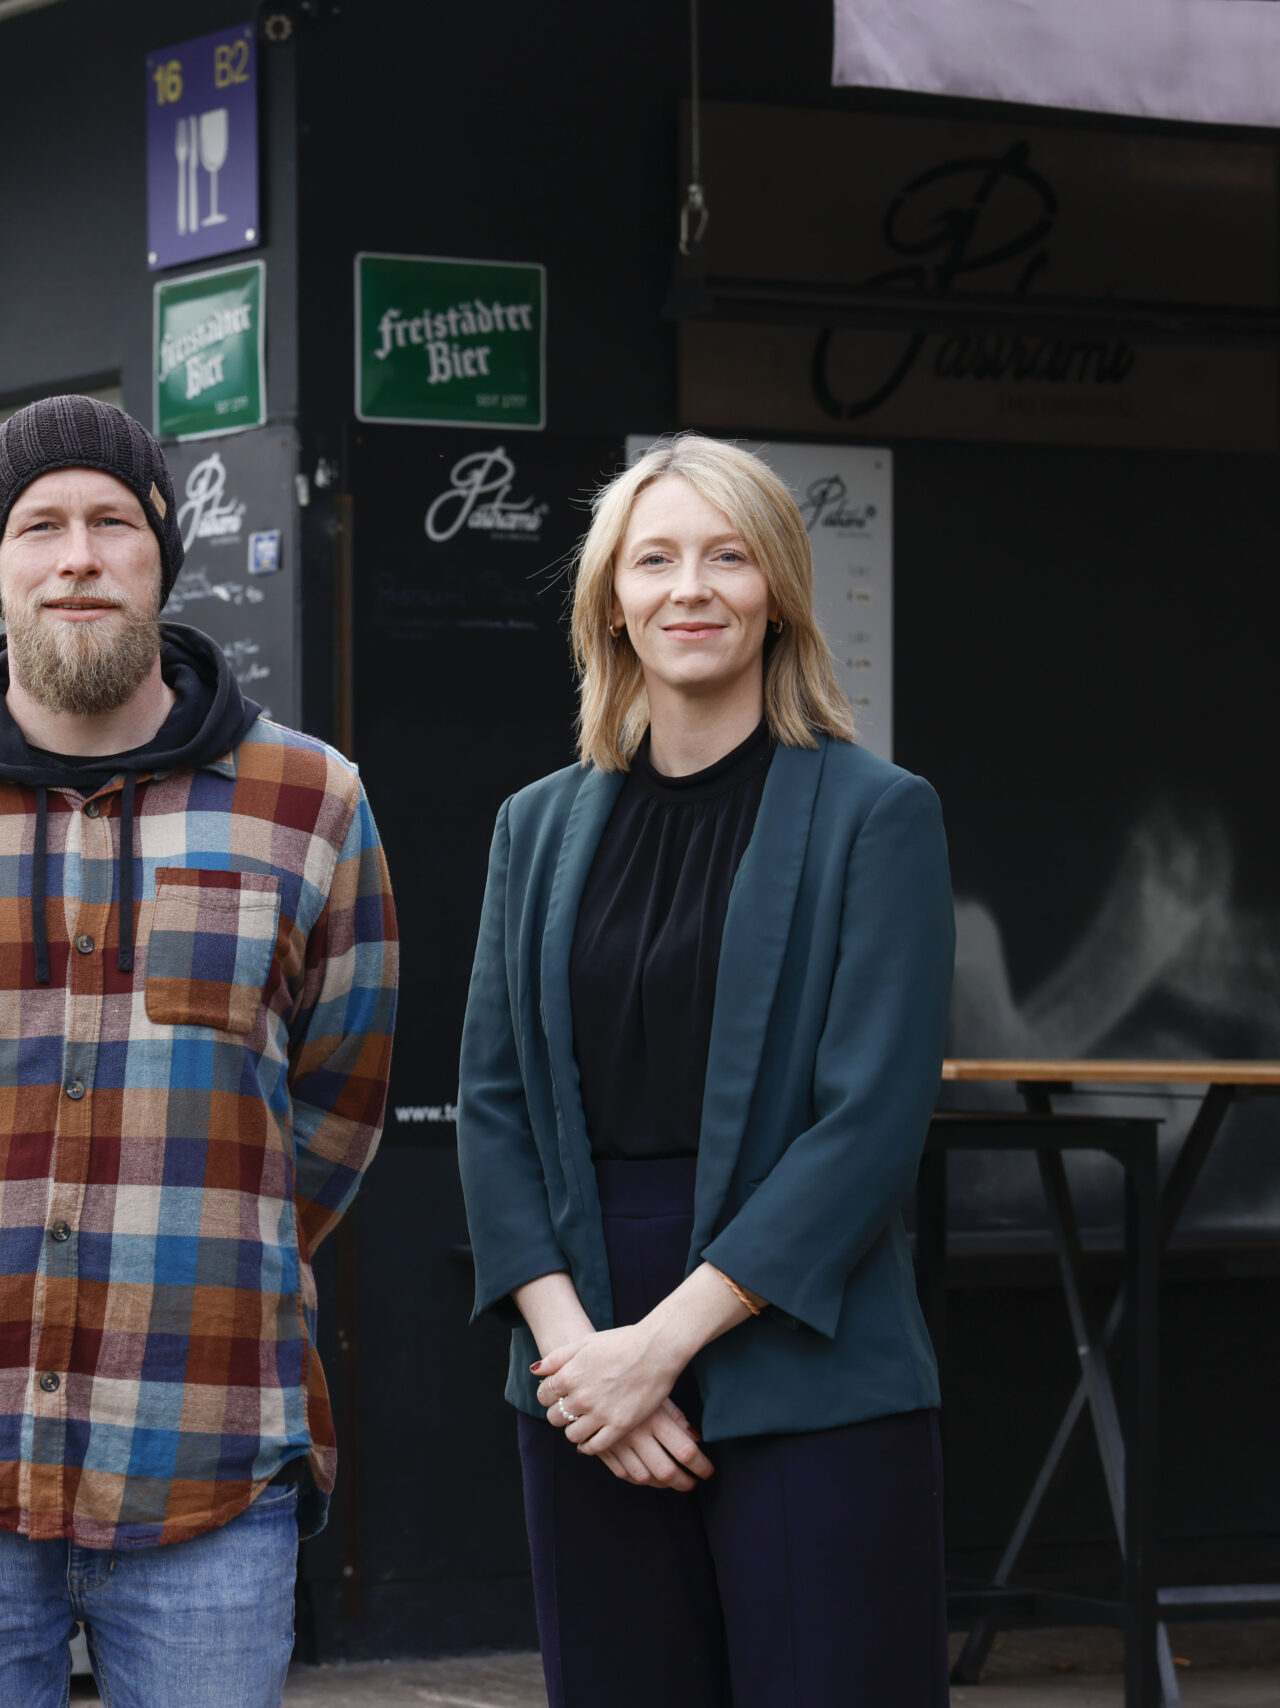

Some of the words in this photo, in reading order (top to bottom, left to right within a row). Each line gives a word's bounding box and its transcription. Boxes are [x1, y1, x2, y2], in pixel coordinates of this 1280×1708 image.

[153, 60, 183, 106] 16
[214, 39, 250, 89] B2
[185, 351, 225, 400] Bier
[426, 342, 492, 385] Bier
[395, 1102, 458, 1122] www.t
